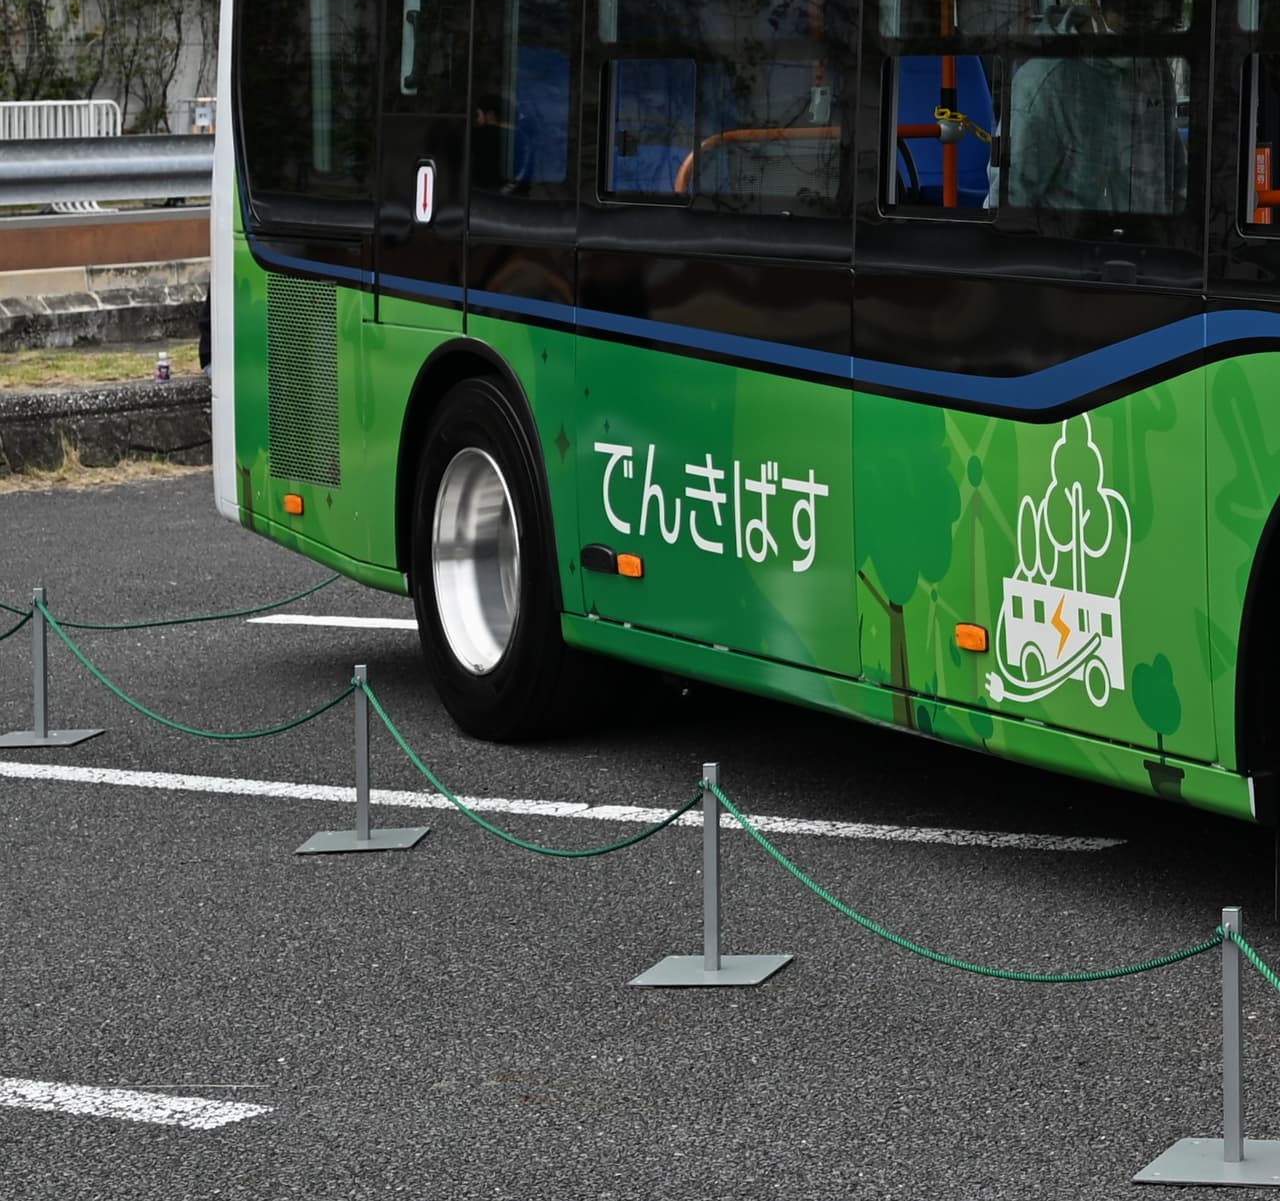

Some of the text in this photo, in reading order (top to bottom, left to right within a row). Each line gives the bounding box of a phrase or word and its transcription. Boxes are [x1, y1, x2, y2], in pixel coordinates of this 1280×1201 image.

[594, 441, 829, 573] でんきばす
